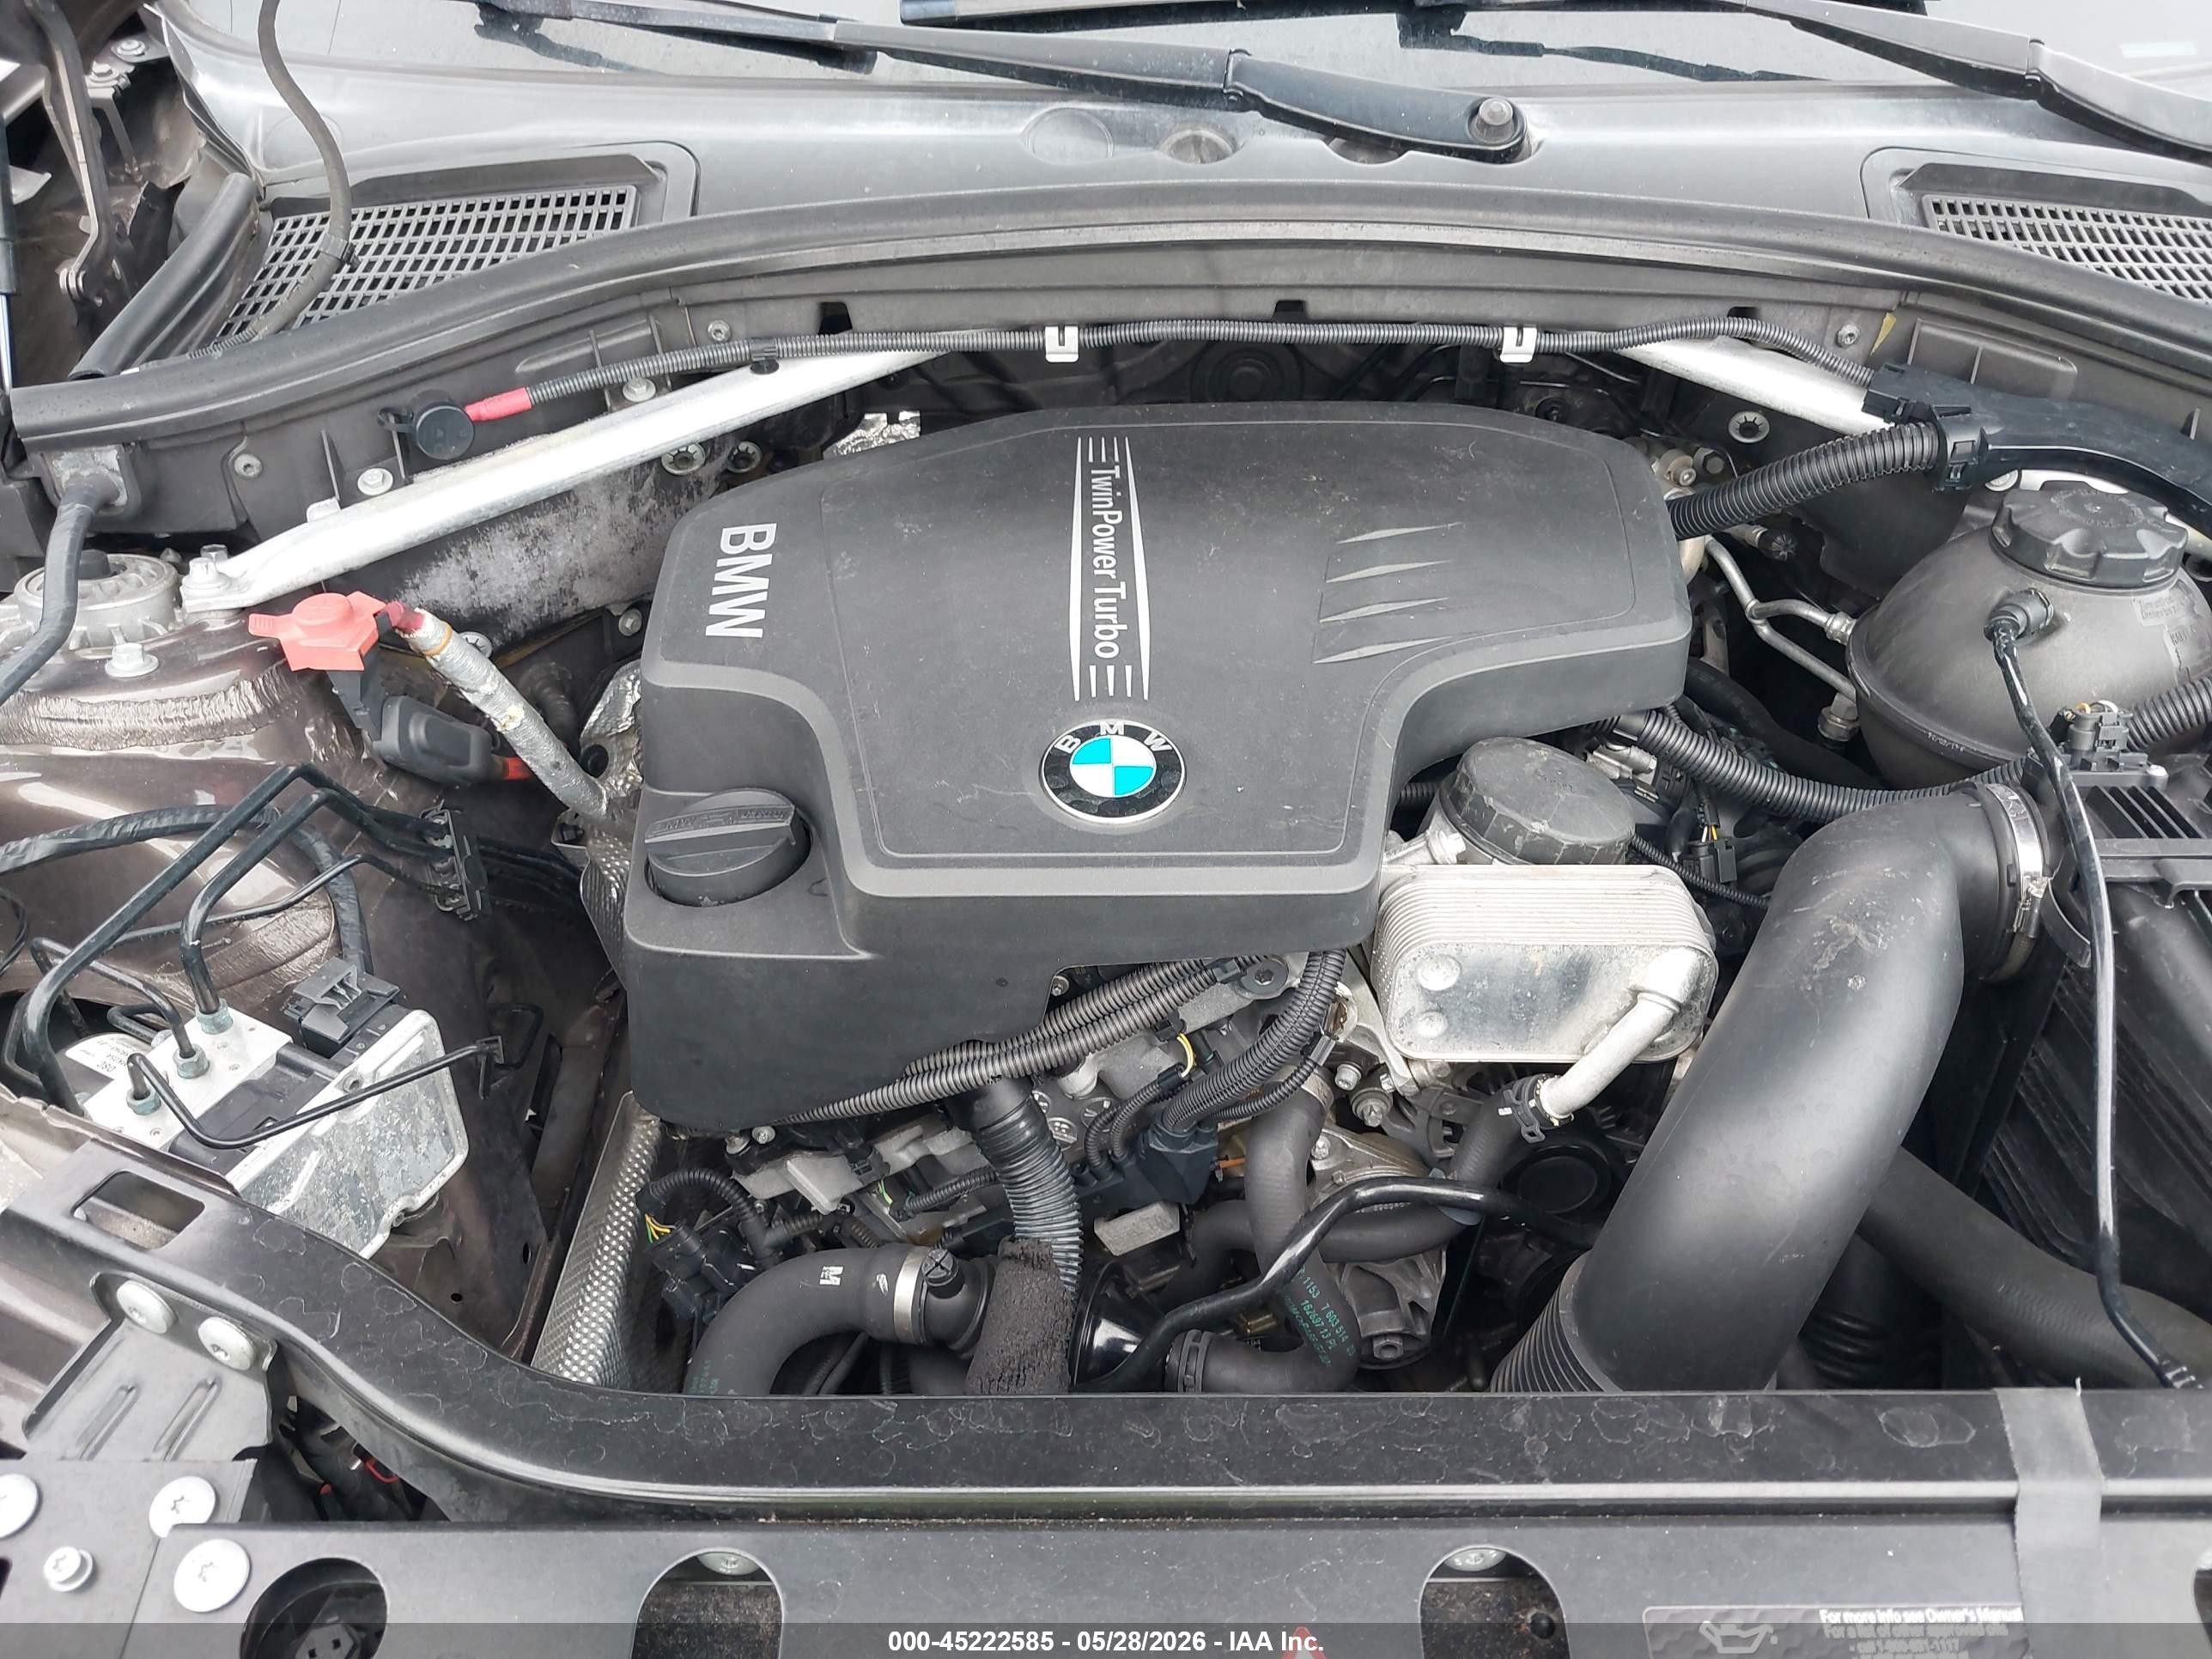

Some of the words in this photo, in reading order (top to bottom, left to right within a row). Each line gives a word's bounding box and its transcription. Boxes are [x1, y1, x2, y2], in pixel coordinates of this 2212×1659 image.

[1091, 465, 1123, 579] TwinPower
[706, 523, 776, 638] BMW
[1093, 581, 1128, 659] Turbo
[1054, 720, 1173, 754] BMW
[1820, 1609, 1842, 1623] For
[1843, 1612, 1875, 1623] more
[1875, 1608, 1902, 1623] info
[1976, 1607, 2024, 1622] Manual
